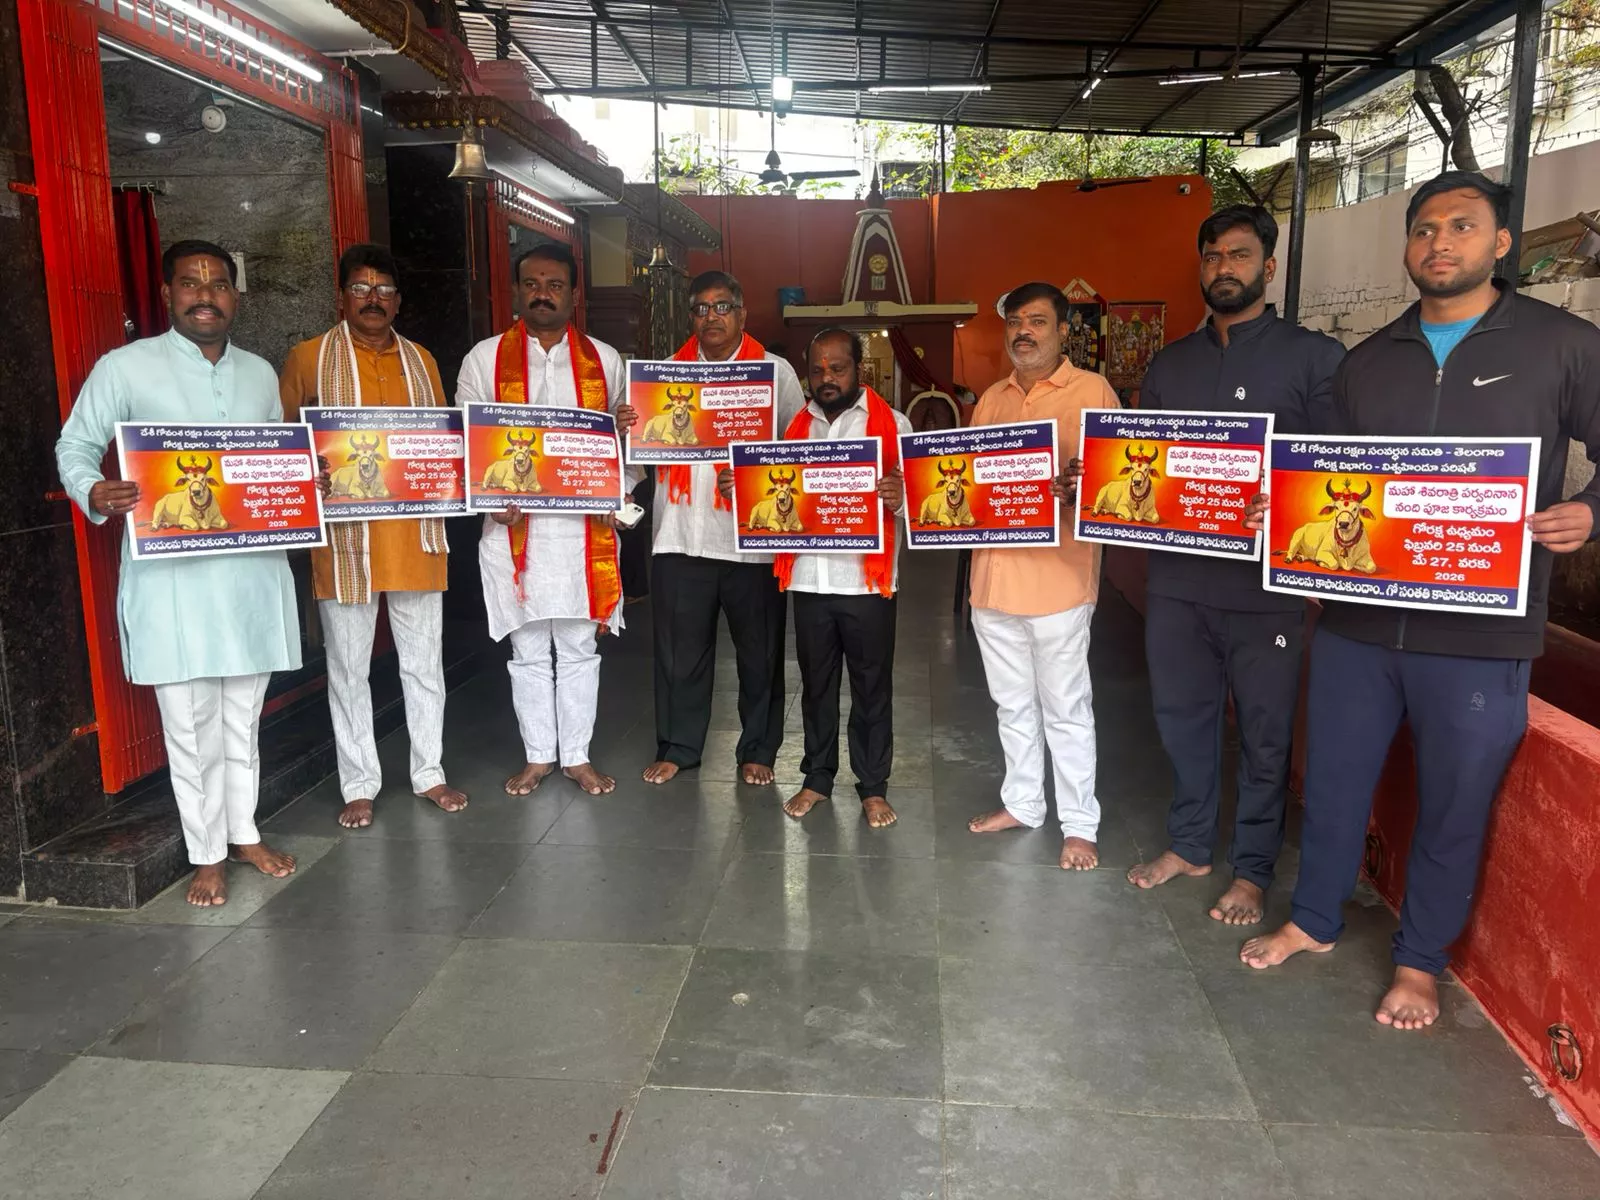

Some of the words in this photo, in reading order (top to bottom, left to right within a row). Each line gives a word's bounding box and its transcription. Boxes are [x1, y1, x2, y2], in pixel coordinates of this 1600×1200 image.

[1307, 443, 1342, 455] గోవంశ
[1342, 446, 1366, 458] రక్షణ
[1410, 447, 1444, 457] సమితి
[1453, 447, 1505, 457] తెలంగాణ
[1313, 459, 1338, 473] గోరక్ష
[1338, 461, 1373, 472] విభాగం
[1381, 462, 1439, 475] విశ్వహిందూ
[1440, 462, 1477, 475] పరిషత్
[270, 497, 284, 506] 25
[1388, 485, 1416, 497] మహా
[1418, 486, 1459, 502] శివరాత్రి
[1461, 487, 1518, 503] పర్వదినాన
[1206, 497, 1221, 507] 25
[1394, 502, 1421, 513] నంది
[1423, 503, 1450, 516] పూజ
[1452, 504, 1508, 520] కార్యక్రమం
[268, 520, 289, 528] 2026
[1198, 522, 1220, 531] 2026
[1412, 522, 1445, 539] గోరక్ష
[1445, 541, 1466, 553] 25
[1467, 542, 1502, 554] నుండి
[1411, 553, 1428, 566] మే
[1457, 557, 1492, 570] వరకు
[1434, 571, 1466, 582] 2026
[1275, 572, 1315, 588] నందులను
[1385, 582, 1399, 597] గో
[1398, 585, 1431, 600] సంతతి
[1431, 588, 1509, 605] కాపాడుకుందాం
